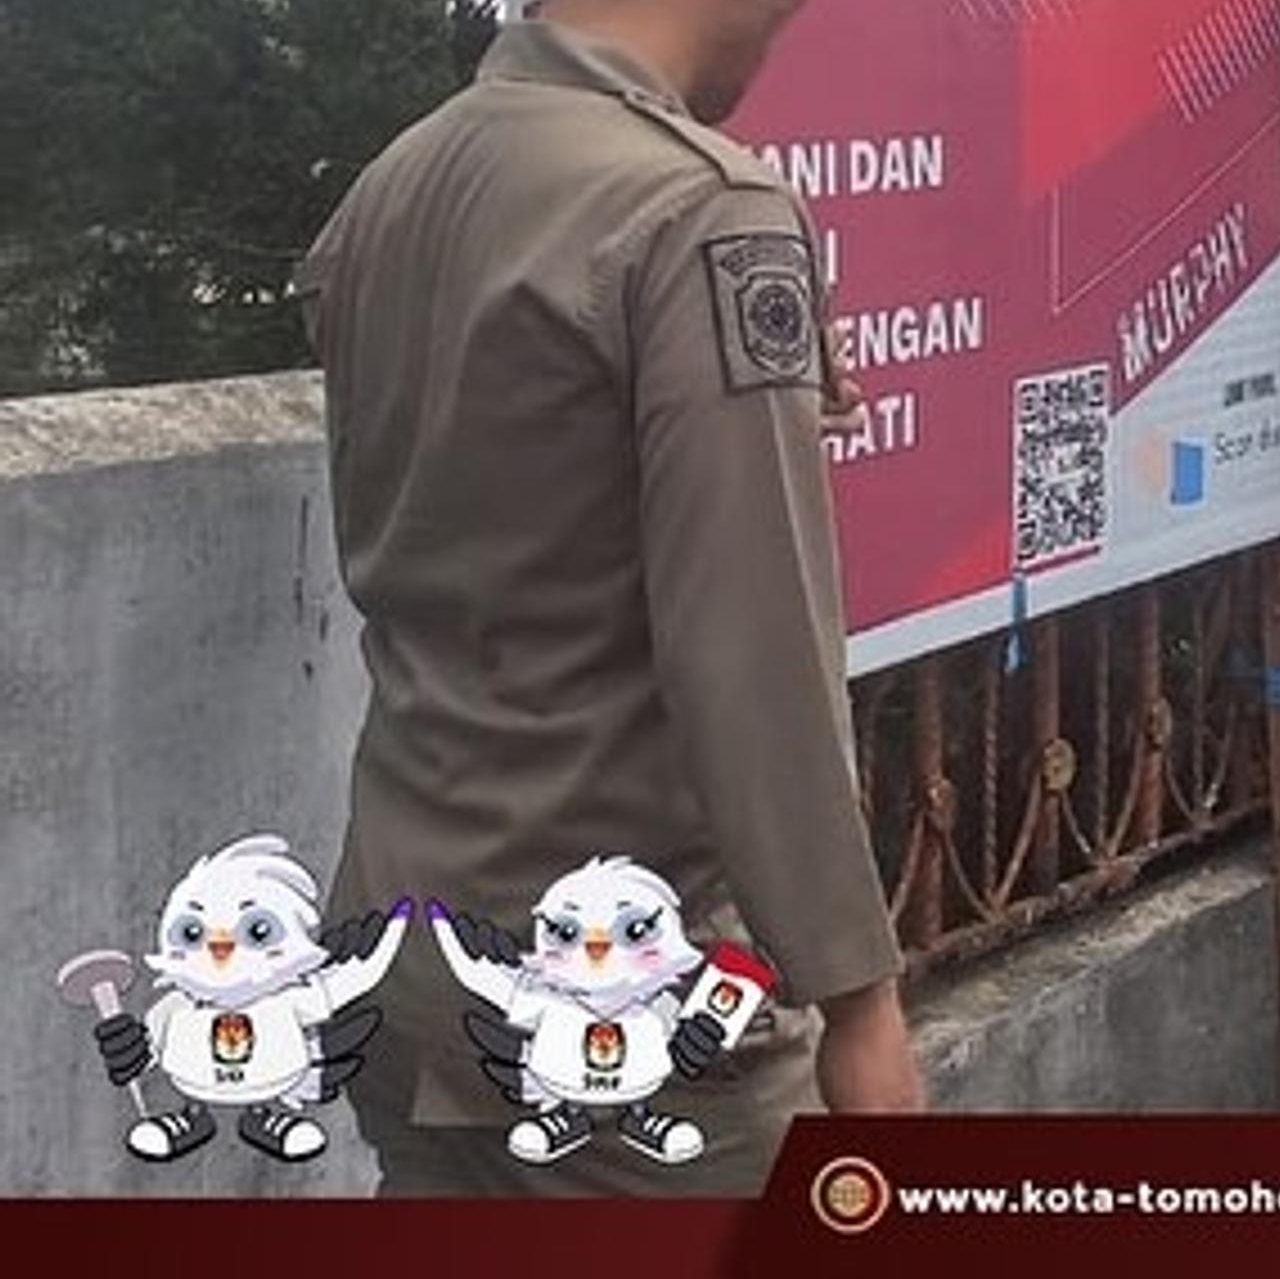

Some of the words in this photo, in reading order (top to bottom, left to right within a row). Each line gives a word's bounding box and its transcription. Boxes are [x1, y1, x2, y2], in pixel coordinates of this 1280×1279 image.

[849, 134, 943, 195] DAN
[1117, 202, 1250, 383] MURPHY
[836, 297, 983, 370] ENGAN
